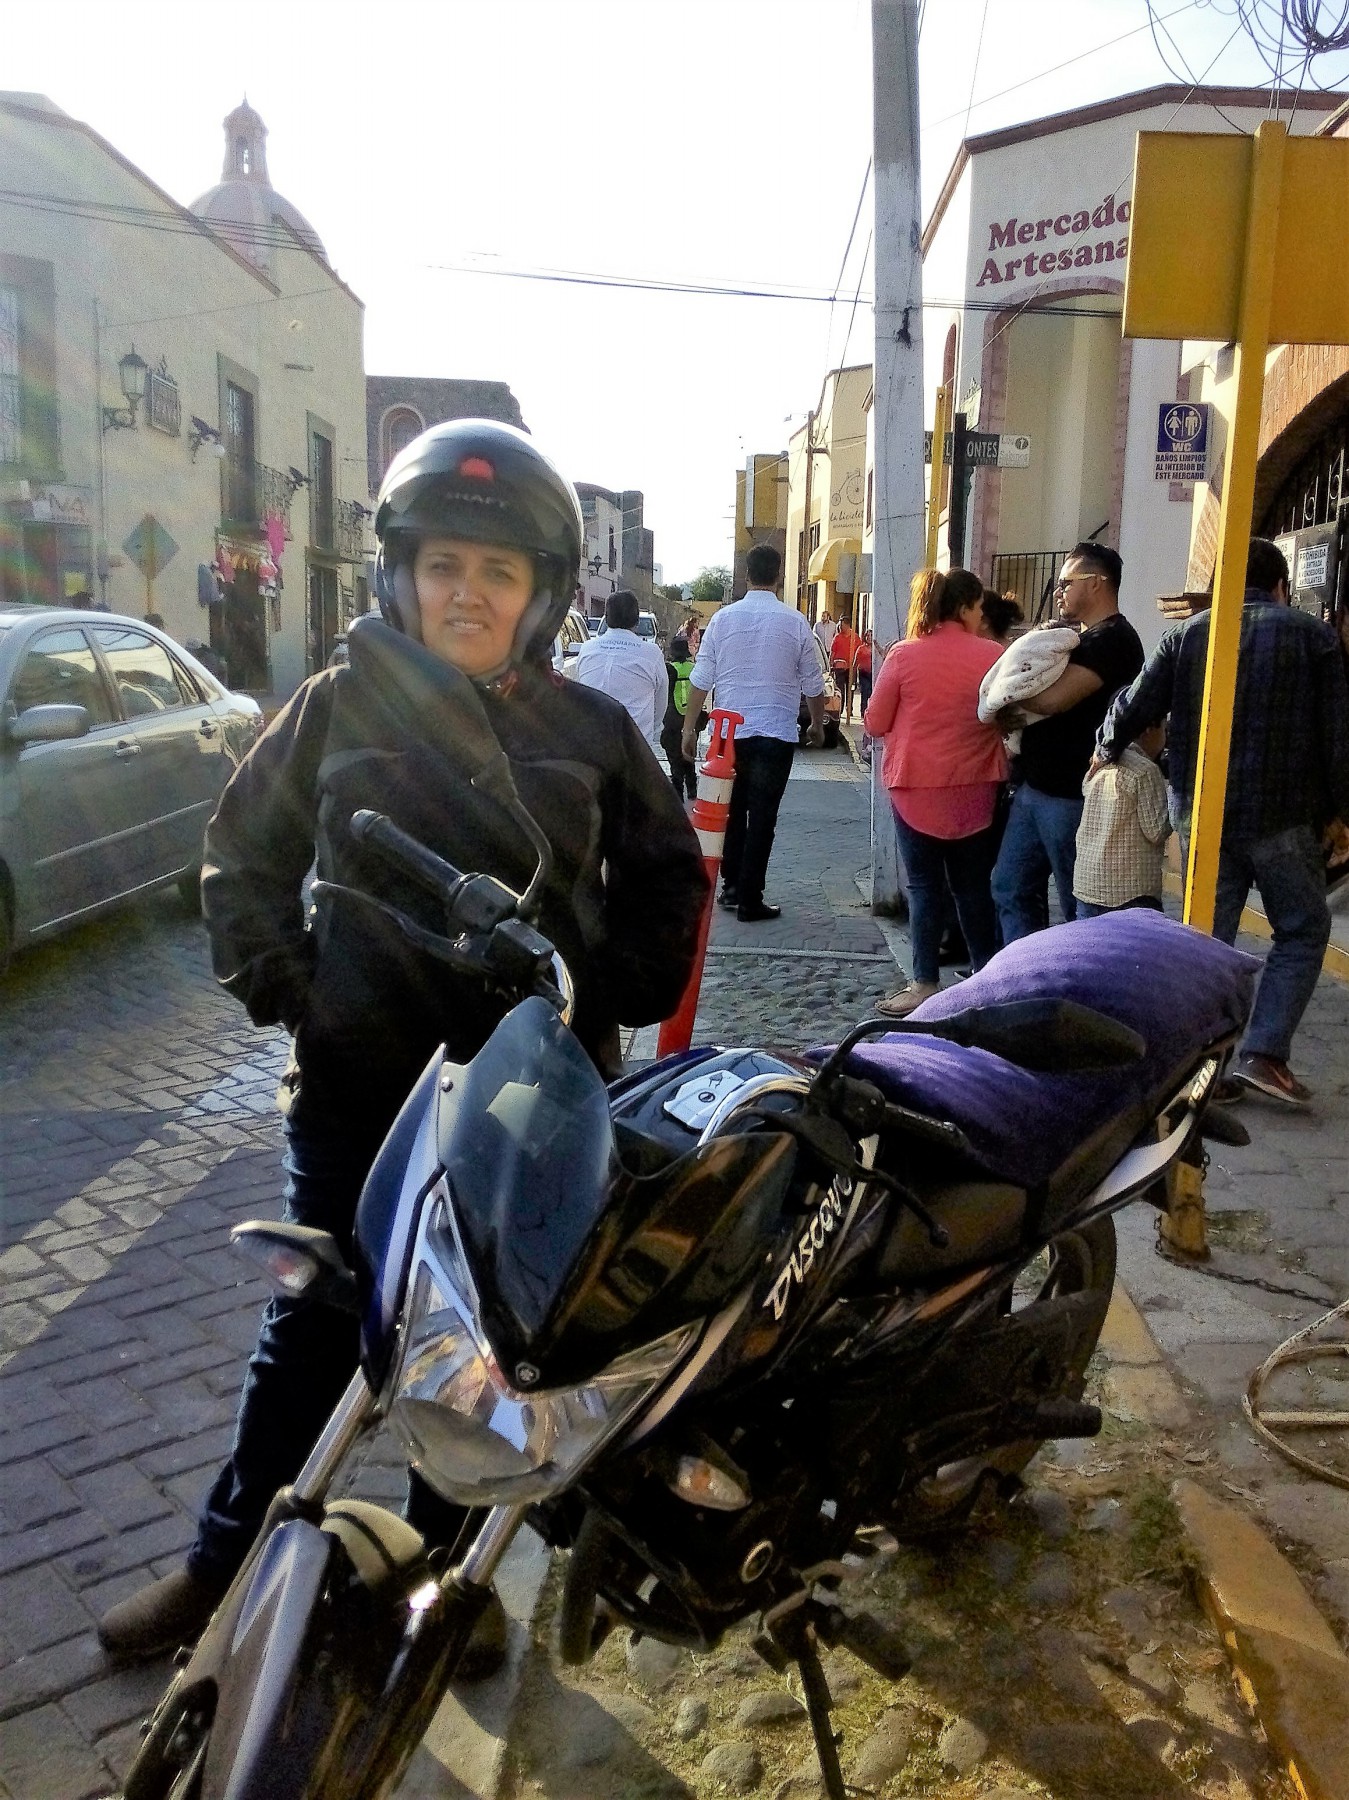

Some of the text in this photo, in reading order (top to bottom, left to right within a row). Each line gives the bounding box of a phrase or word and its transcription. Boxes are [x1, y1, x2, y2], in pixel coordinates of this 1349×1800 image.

[988, 194, 1132, 251] Mercado
[966, 440, 998, 459] ONTES
[1172, 442, 1193, 452] WC
[1155, 453, 1207, 462] BAÑOS LIMPIOS
[1155, 463, 1205, 471] AL INTERIOR DE
[1155, 472, 1205, 480] ESTE MERCADO
